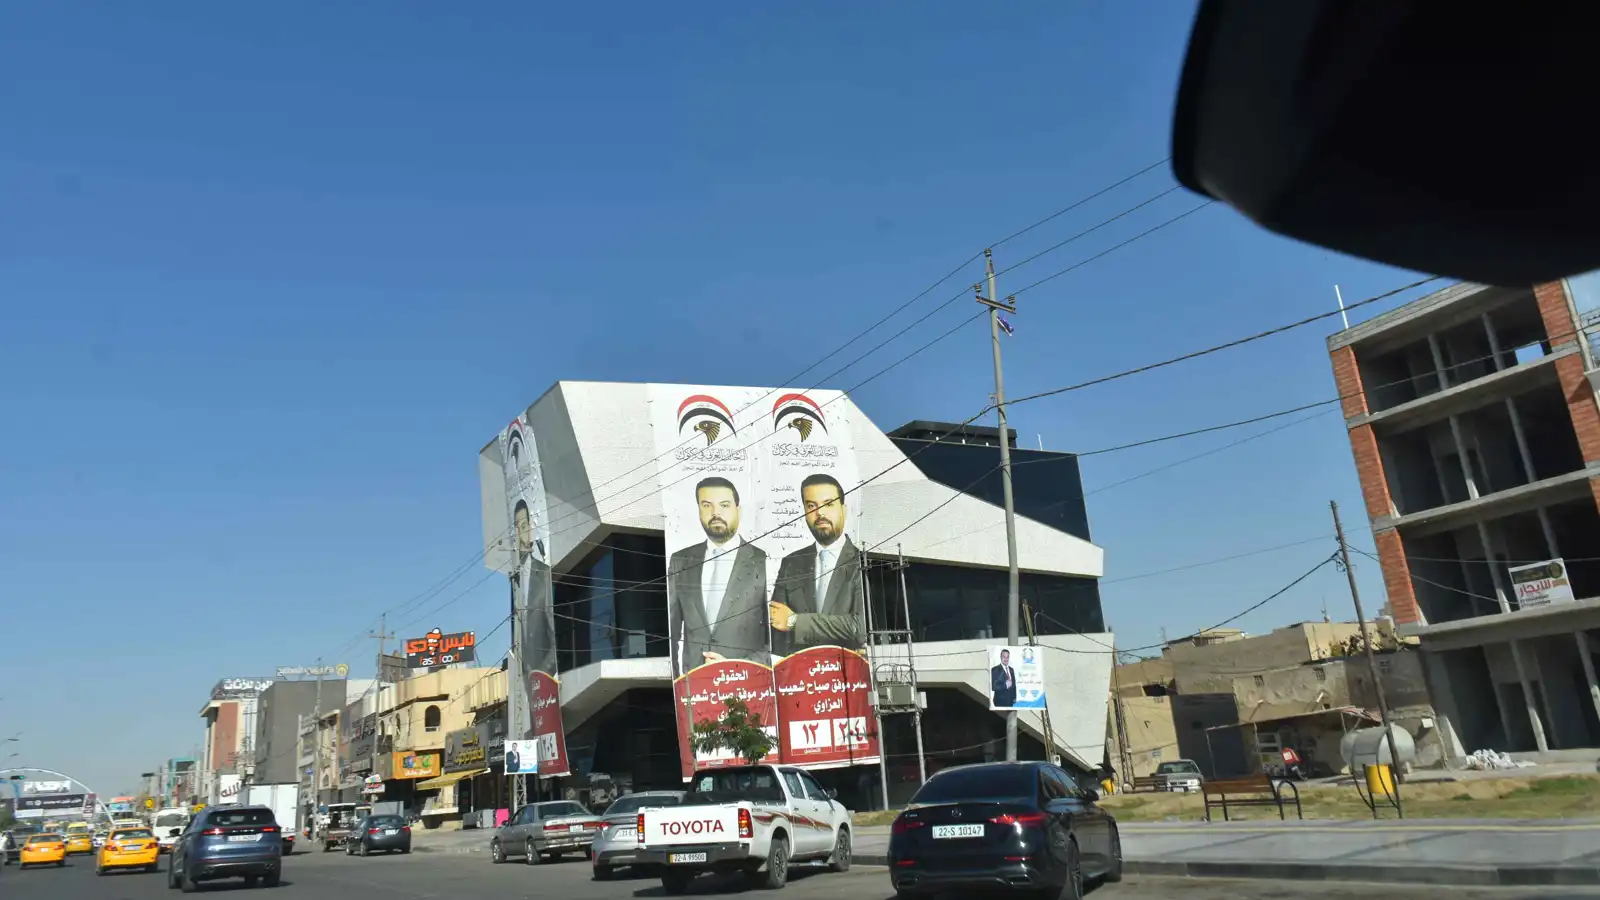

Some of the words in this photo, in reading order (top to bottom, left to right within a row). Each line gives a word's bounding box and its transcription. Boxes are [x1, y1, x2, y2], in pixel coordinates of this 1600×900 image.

[772, 443, 793, 456] كركوك
[809, 660, 842, 677] الحقوقي
[712, 669, 749, 686] الحقوقي
[778, 680, 805, 696] شعيب
[807, 681, 830, 695] صباح
[709, 689, 734, 704] صباح
[813, 698, 843, 714] العزاوي
[660, 819, 724, 835] TOYOTA
[938, 827, 956, 837] 22-S
[958, 826, 981, 836] 10147
